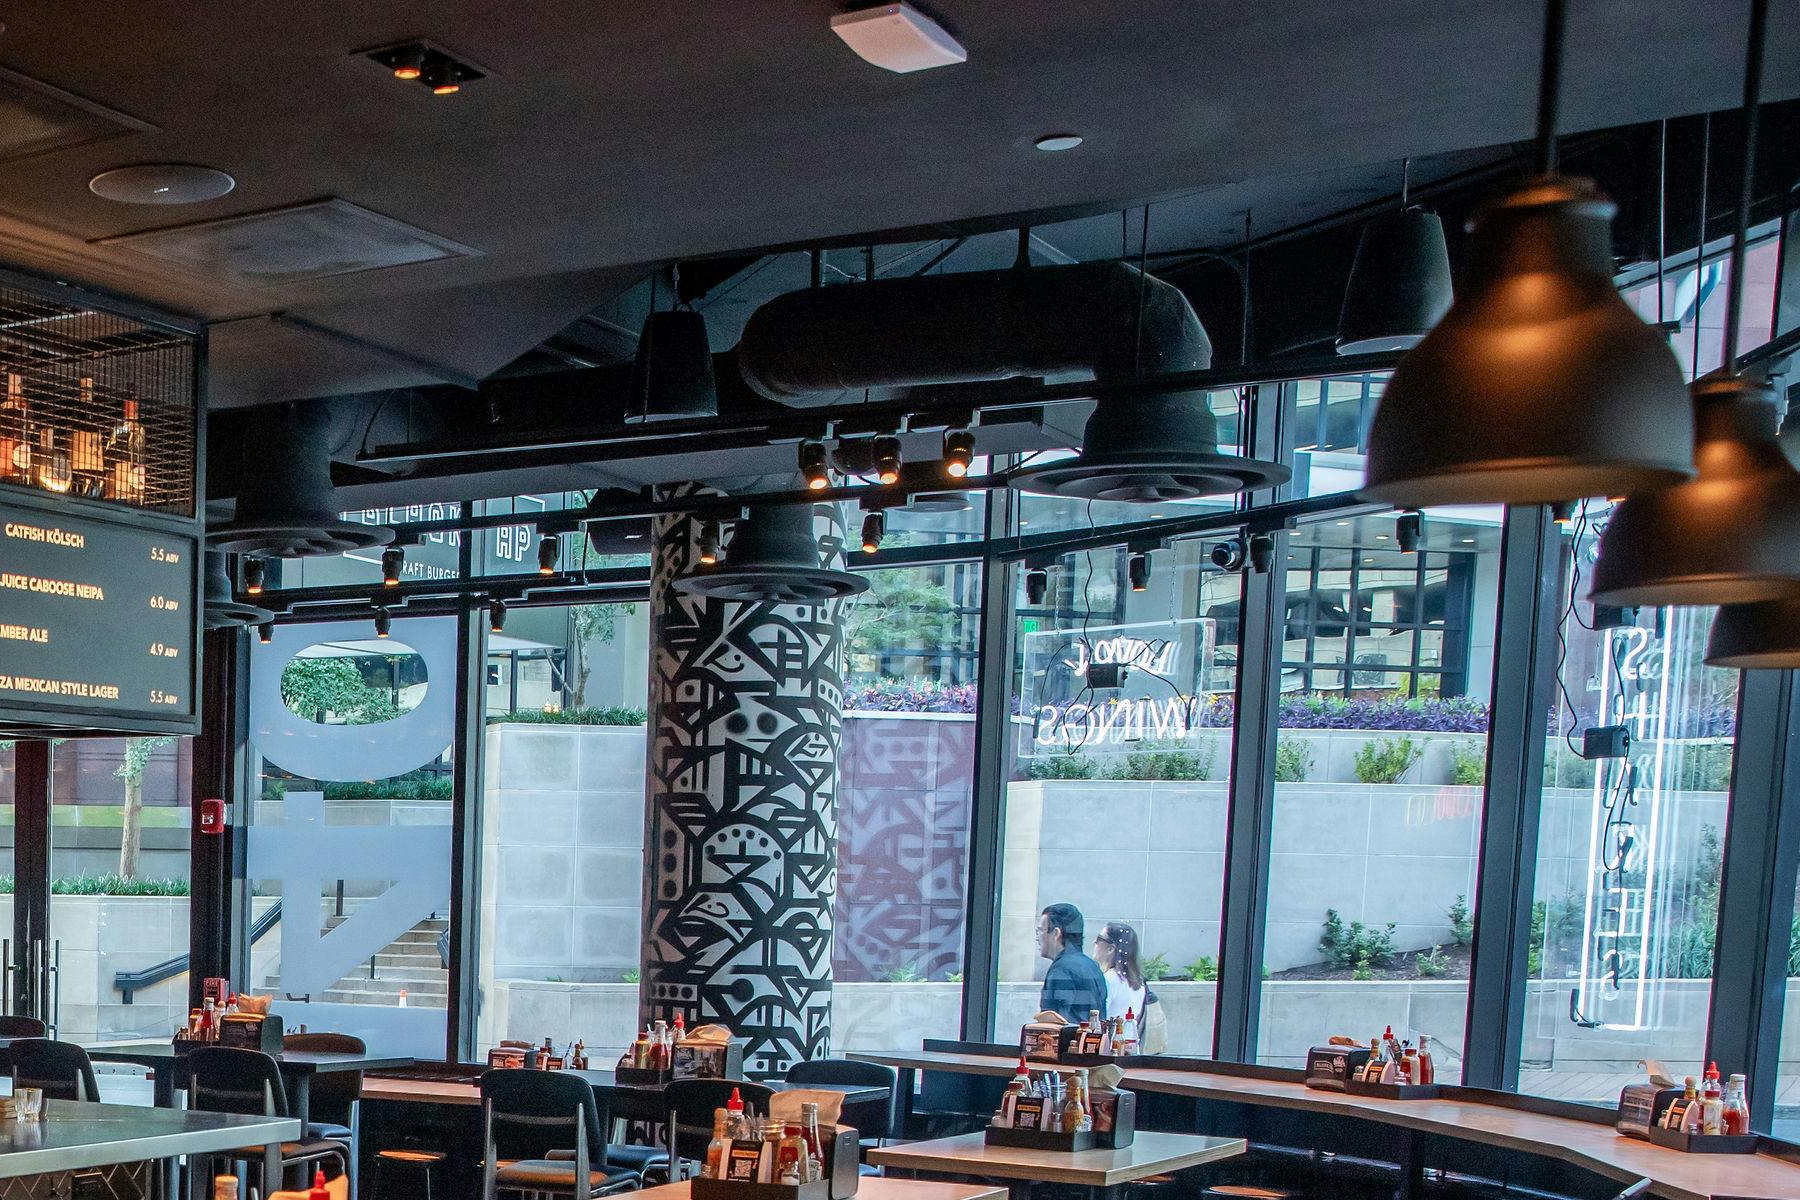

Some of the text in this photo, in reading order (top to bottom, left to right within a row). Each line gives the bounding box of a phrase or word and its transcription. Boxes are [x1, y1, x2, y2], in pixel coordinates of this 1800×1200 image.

[5, 523, 45, 541] CATFISH
[46, 529, 84, 548] KÖLSCH
[151, 547, 179, 563] 5.5 ABV
[402, 560, 424, 577] RAFT
[0, 574, 27, 589] JUICE
[29, 577, 74, 596] CABOOSE
[76, 584, 104, 600] NEIPA
[150, 596, 178, 610] 6.0 ABV
[29, 628, 48, 642] ALE
[150, 643, 178, 657] 4.9 ABV
[15, 677, 59, 693] MEXICAN
[60, 682, 84, 696] STYLE
[84, 684, 119, 699] LAGER
[150, 690, 177, 704] 5.5 ABV
